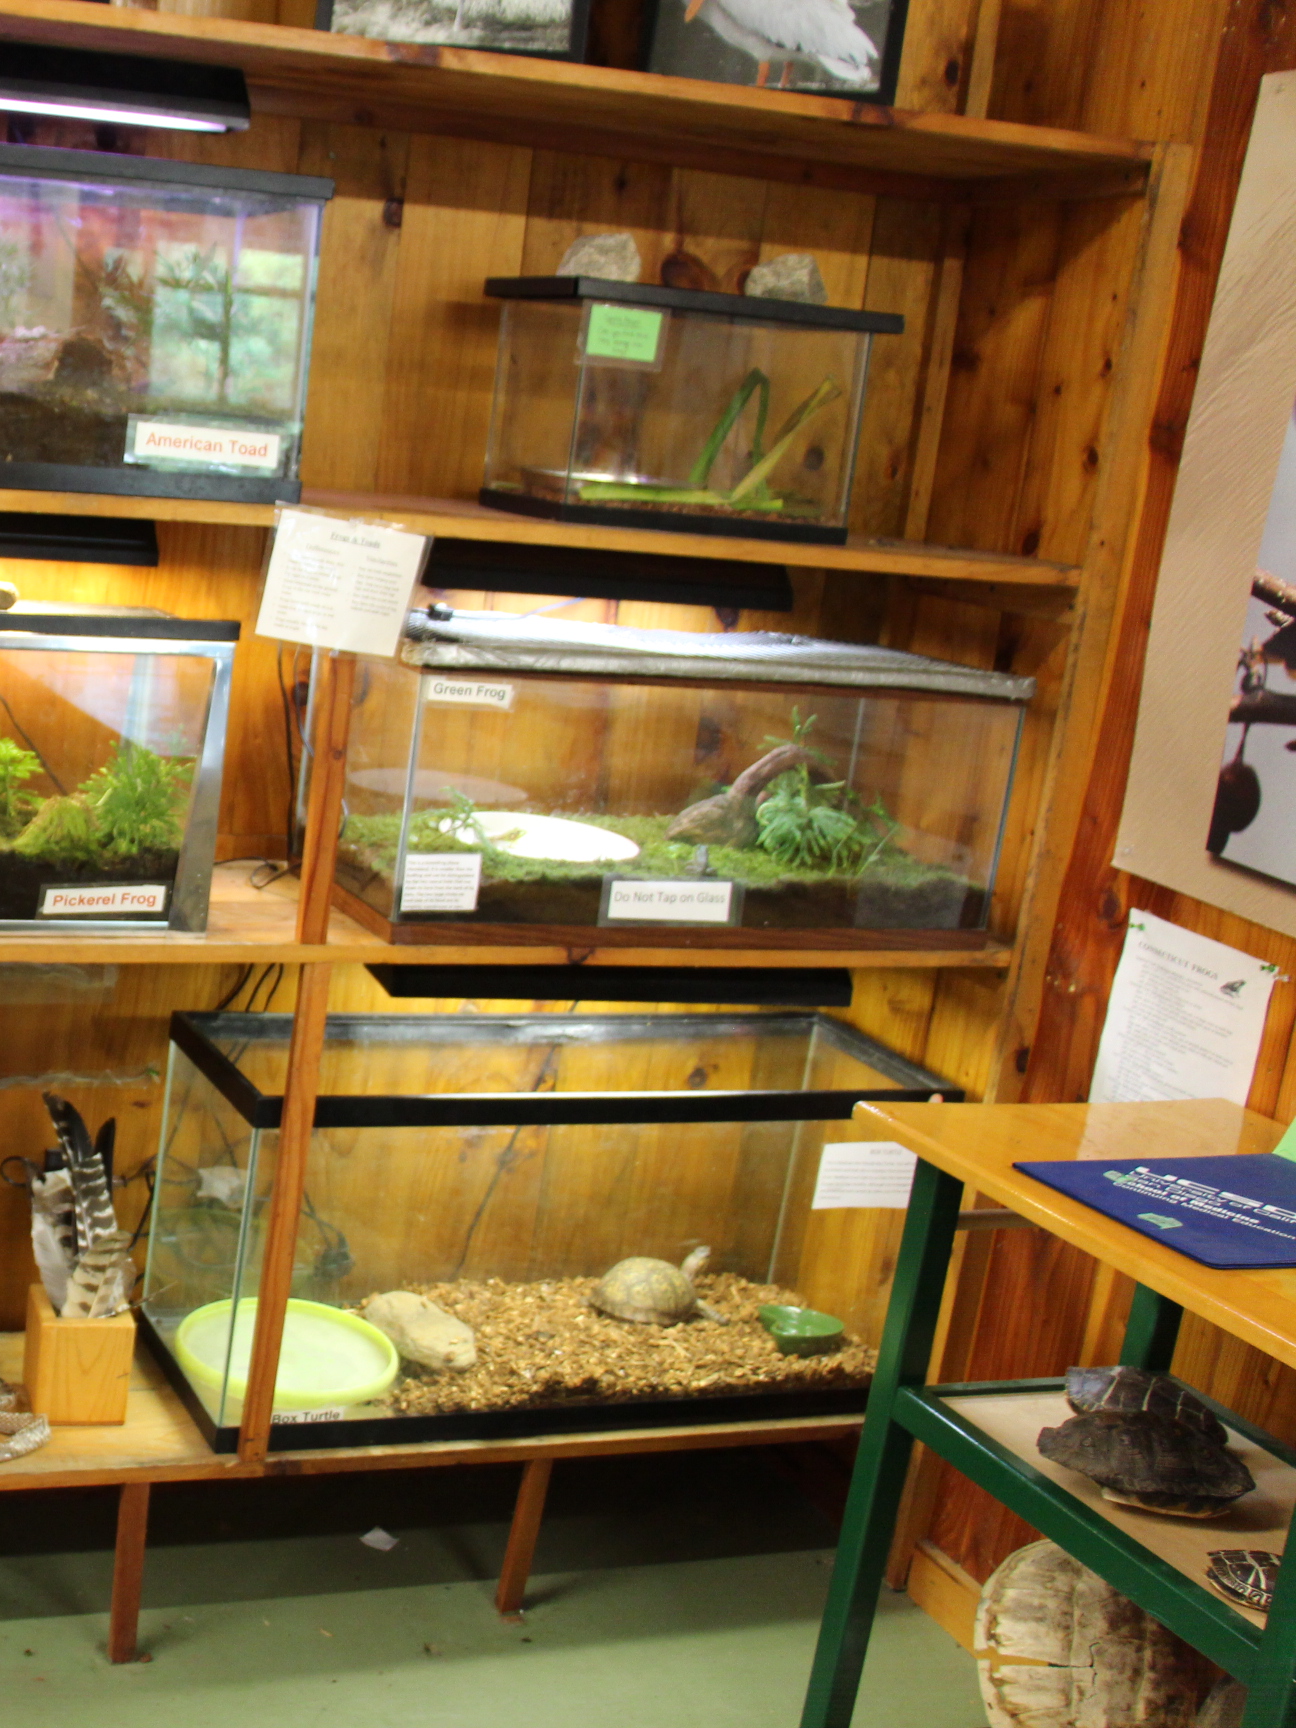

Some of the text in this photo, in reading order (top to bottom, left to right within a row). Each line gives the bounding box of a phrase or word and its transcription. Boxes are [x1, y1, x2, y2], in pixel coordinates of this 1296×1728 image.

[145, 431, 268, 457] American Toad
[433, 682, 506, 701] Green Frog
[52, 892, 157, 908] Pickerel Frog
[614, 891, 726, 905] Do Not Tap on Glass
[1125, 1170, 1228, 1203] University
[1228, 1201, 1255, 1210] of
[1164, 1186, 1222, 1207] Diego
[1113, 1181, 1296, 1240] Continuing Medical Education
[1117, 1180, 1261, 1224] chool of Medicine
[271, 1410, 341, 1424] Box Turtle
